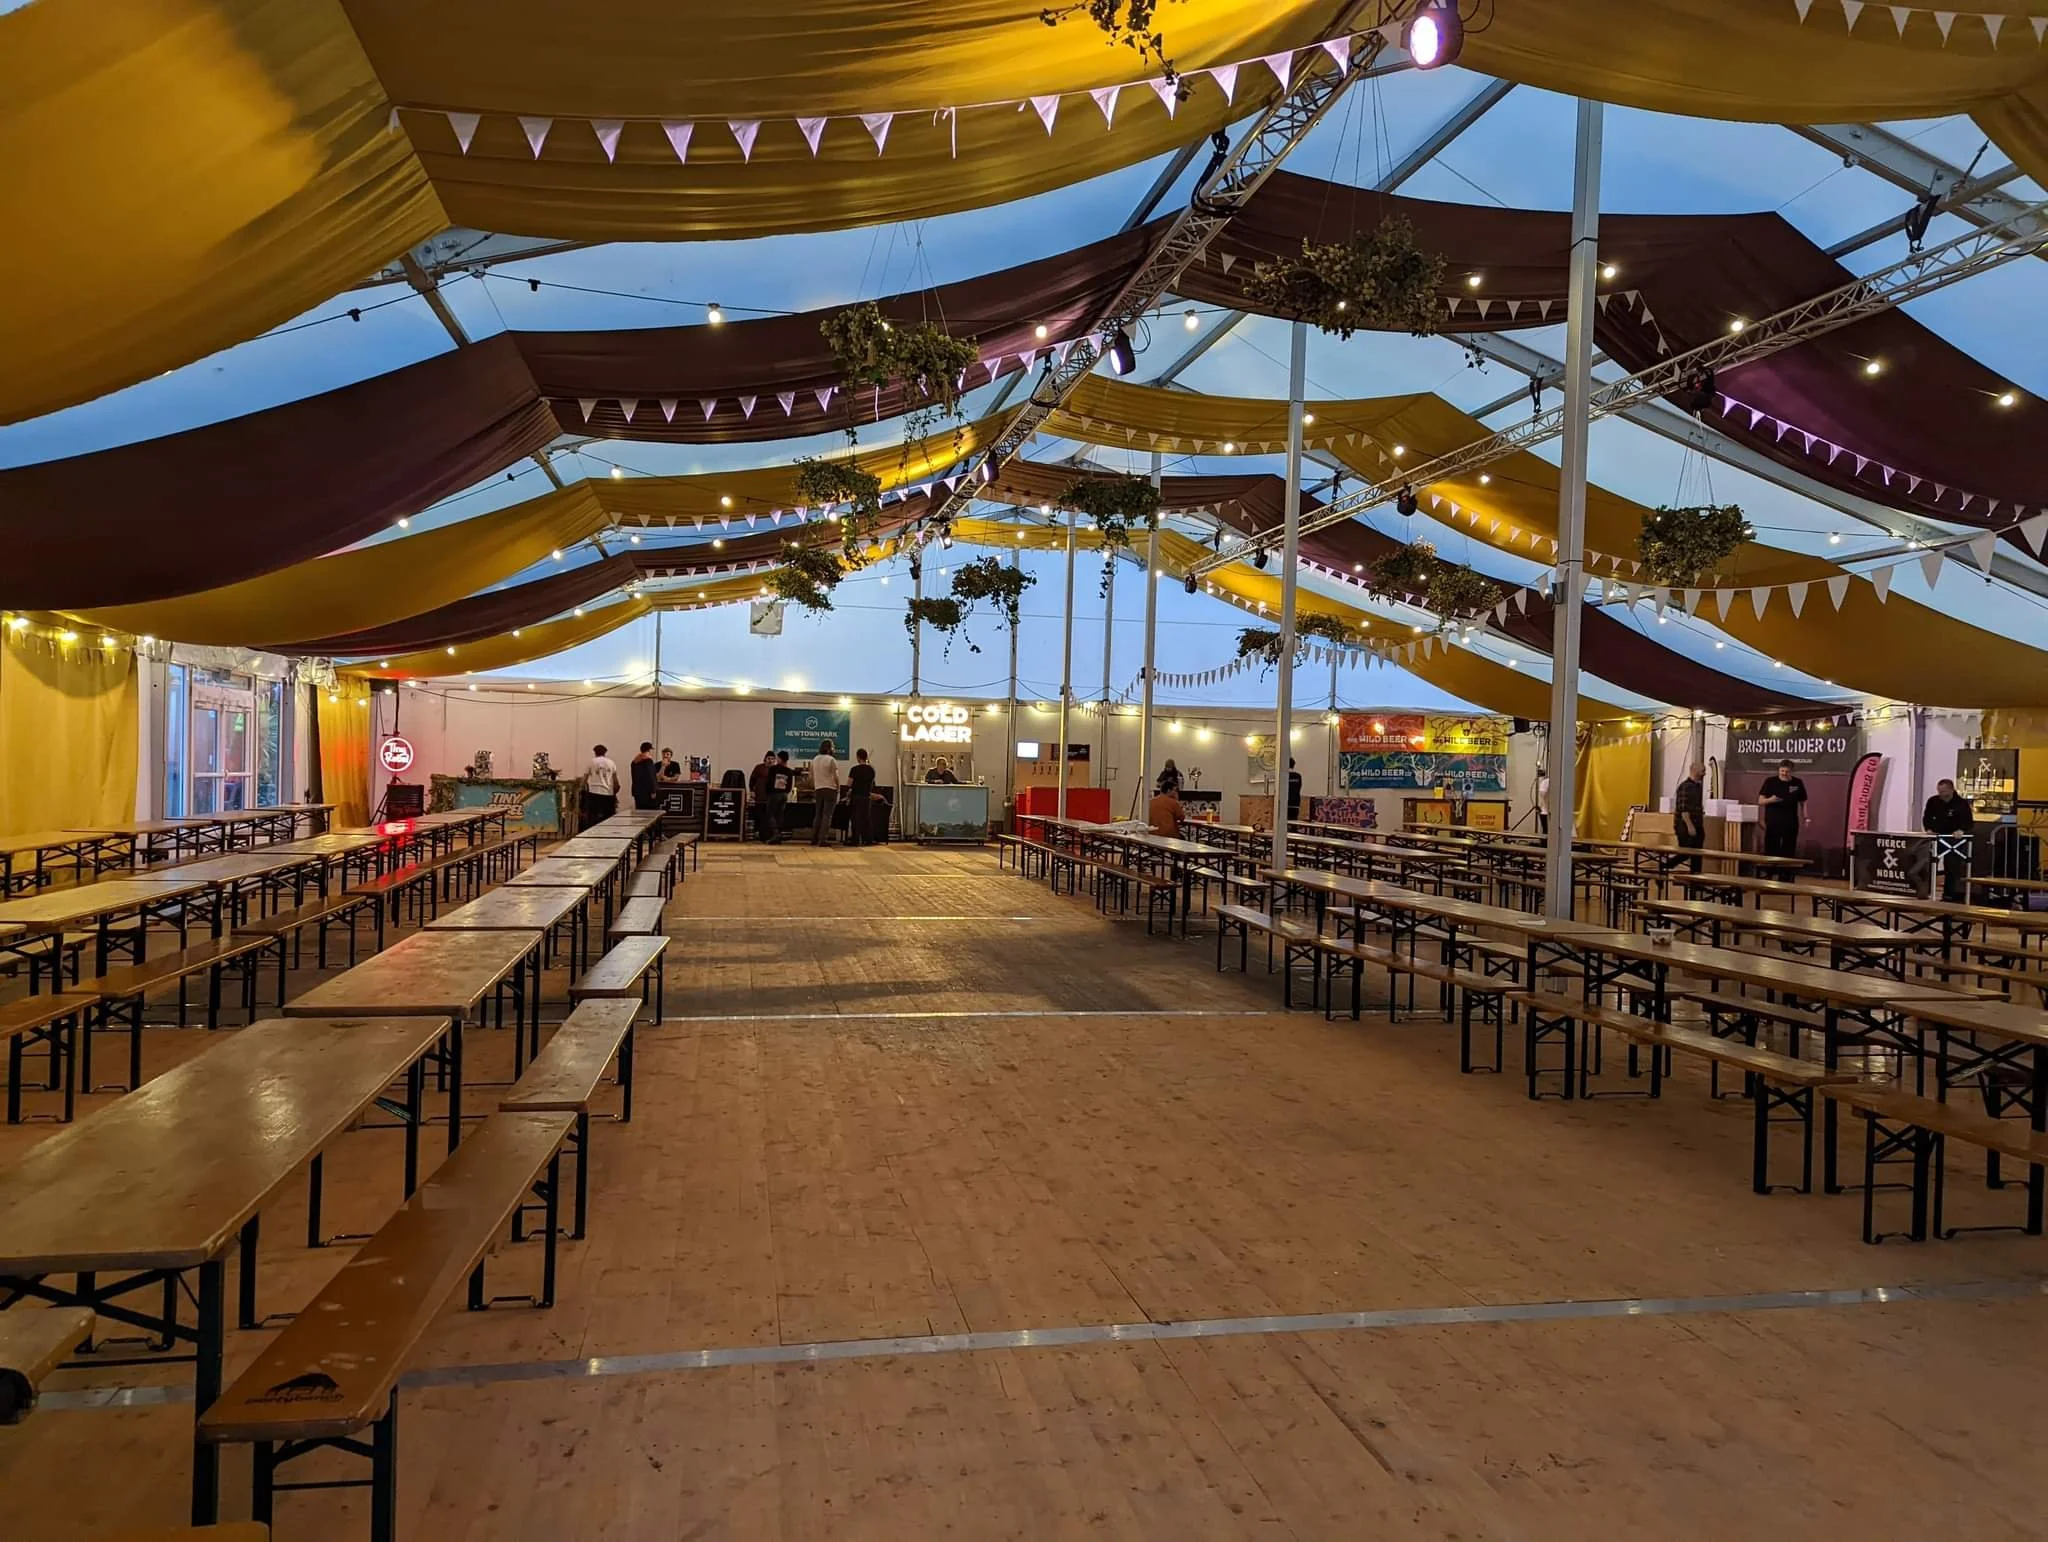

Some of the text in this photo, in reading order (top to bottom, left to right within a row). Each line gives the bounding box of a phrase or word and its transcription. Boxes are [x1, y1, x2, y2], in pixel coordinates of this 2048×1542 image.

[907, 704, 969, 724] COLD
[785, 730, 820, 738] NEWTOWN
[901, 723, 972, 744] LAGER
[1359, 735, 1381, 743] WILD
[1382, 735, 1408, 743] BEER
[1467, 737, 1492, 745] BEER
[1738, 738, 1846, 753] BRISTOL CIDER CO
[1361, 769, 1381, 777] WILD
[1382, 769, 1405, 777] BEER
[1444, 770, 1465, 778] WILD
[1466, 770, 1488, 778] BEER
[492, 792, 521, 804] TINY
[1877, 839, 1907, 848] FIERCE
[1877, 869, 1905, 880] NOBLE
